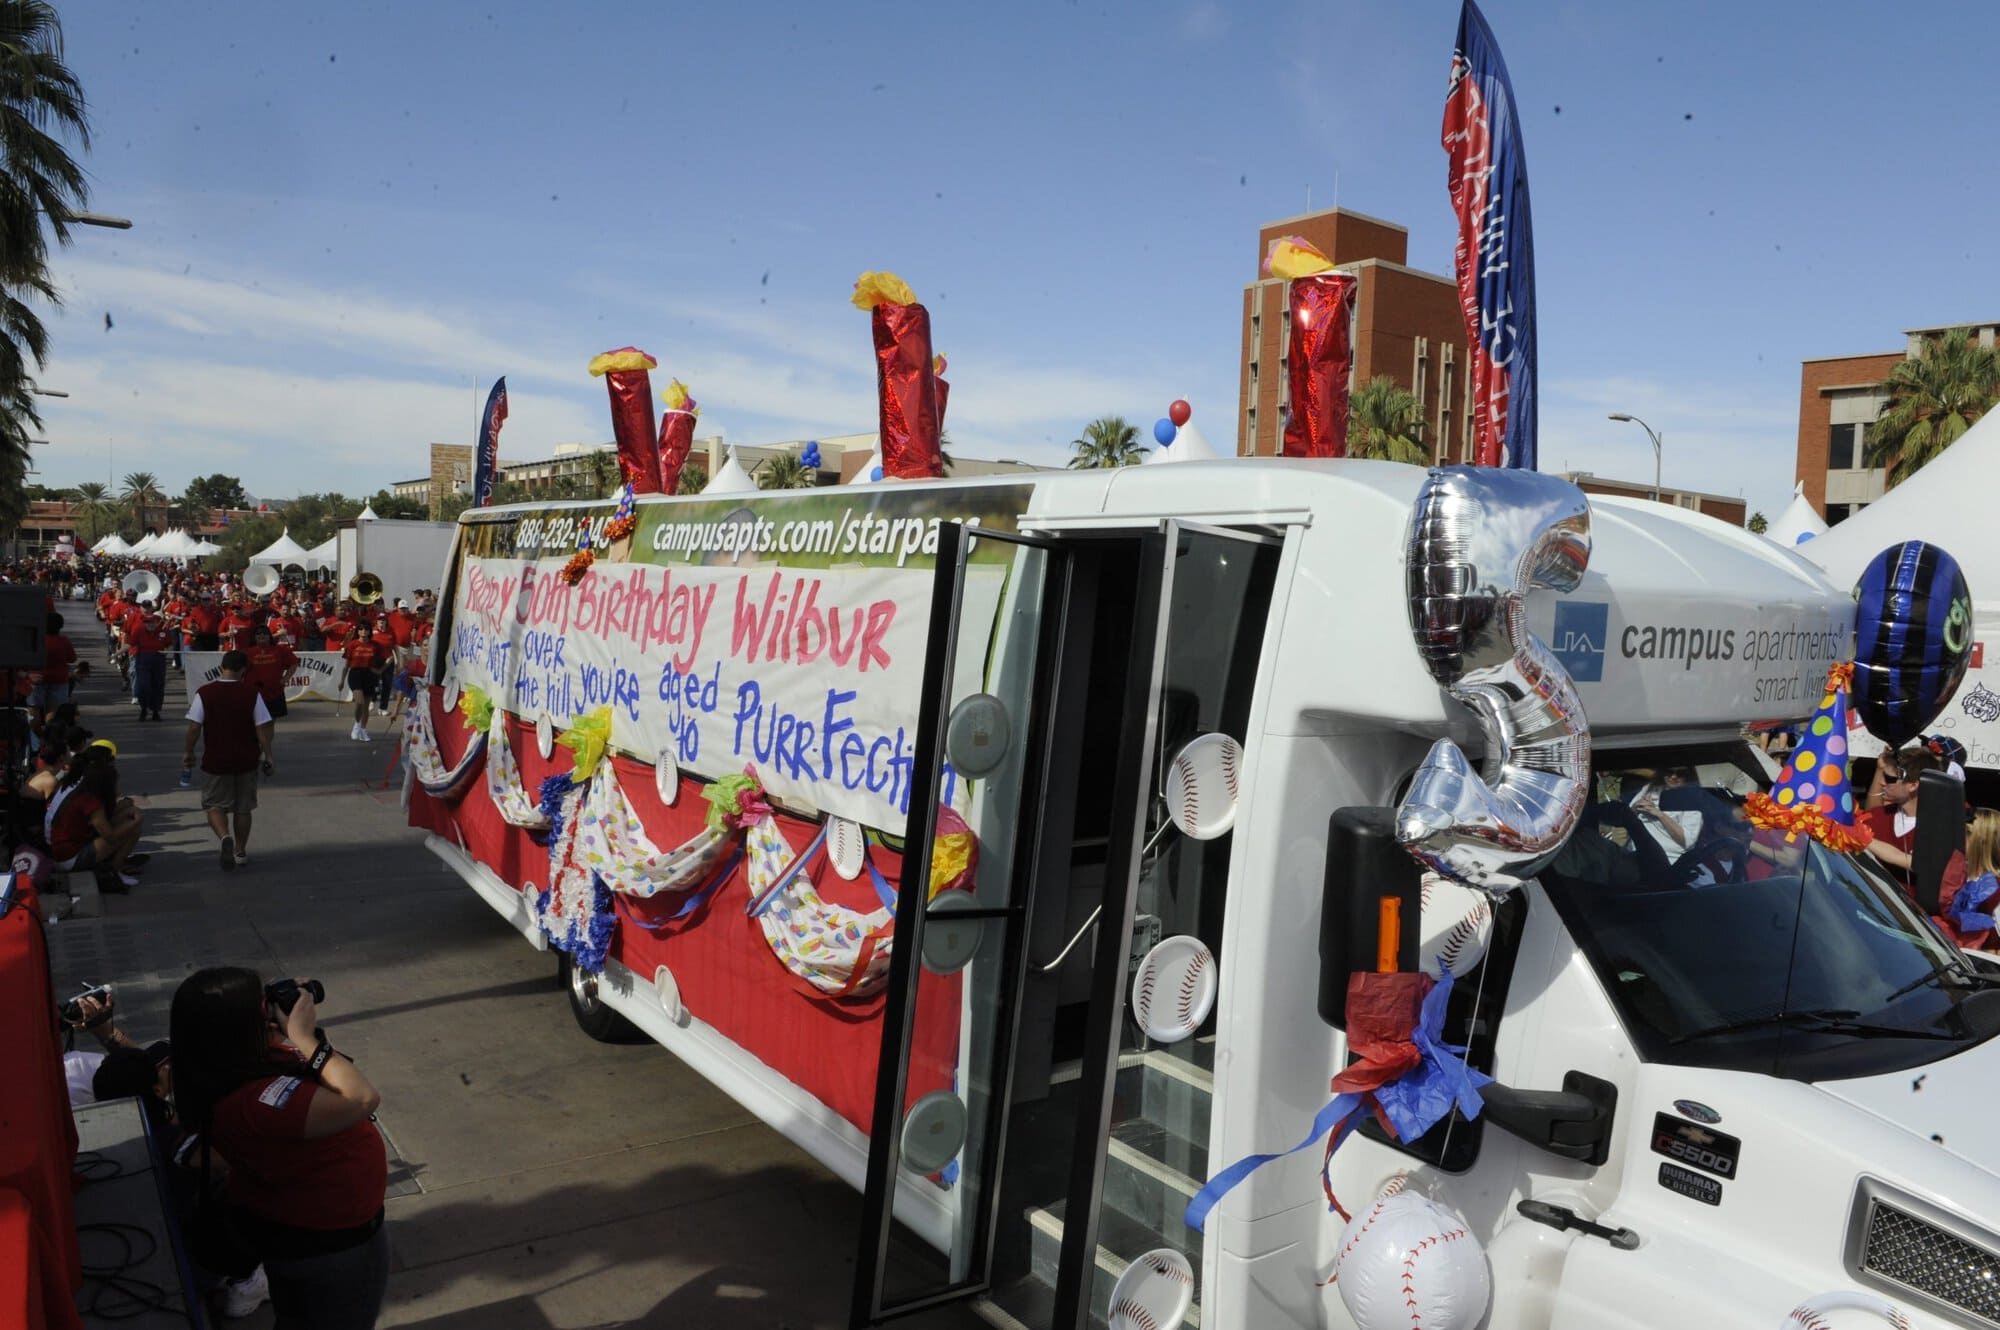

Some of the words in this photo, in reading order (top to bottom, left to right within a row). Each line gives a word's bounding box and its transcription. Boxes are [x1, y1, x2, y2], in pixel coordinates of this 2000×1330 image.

[516, 516, 615, 550] 888-232-145
[653, 508, 981, 567] campusapts.com/starpa
[1621, 624, 1735, 670] campus
[546, 672, 571, 719] hill
[659, 660, 721, 733] aged
[676, 717, 699, 763] to
[1662, 1164, 1720, 1193] DURAMAX
